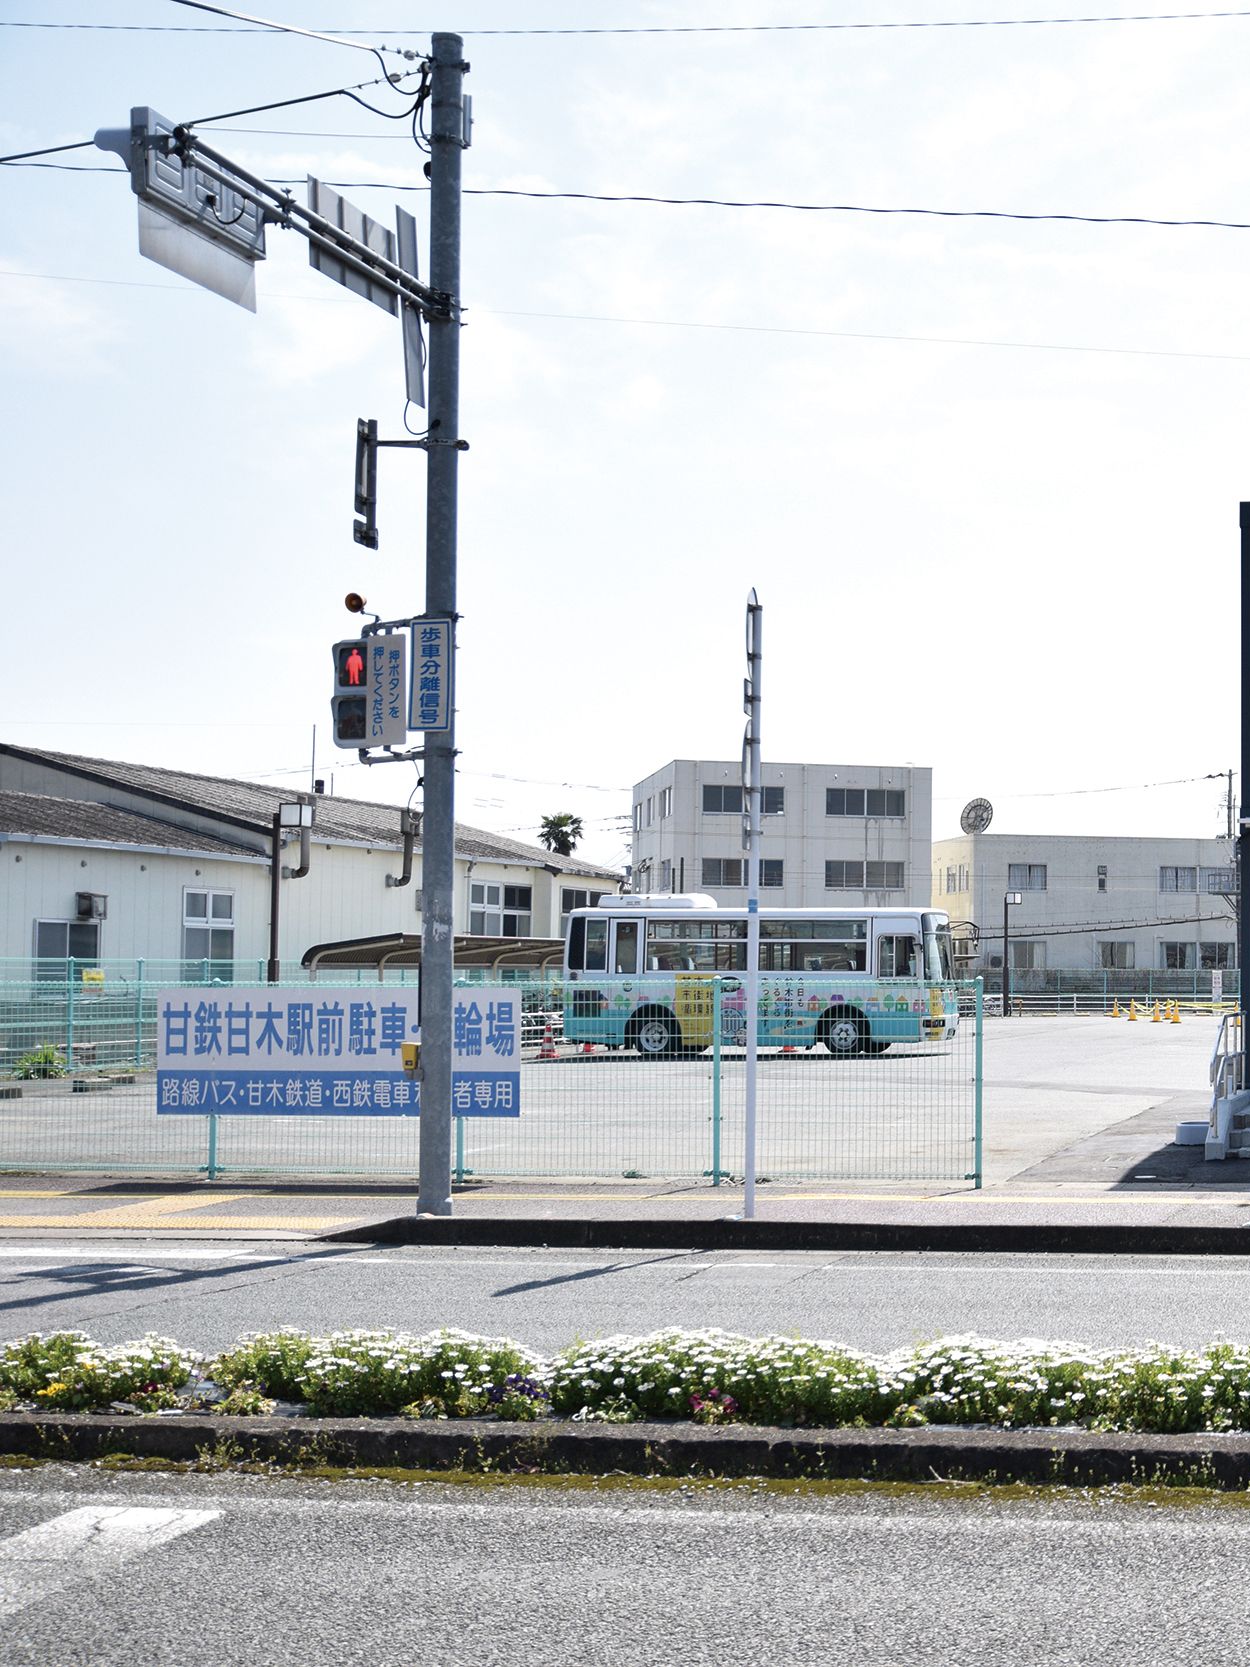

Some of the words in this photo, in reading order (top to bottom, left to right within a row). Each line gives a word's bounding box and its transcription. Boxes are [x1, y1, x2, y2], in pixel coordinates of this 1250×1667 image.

[372, 646, 384, 737] 押してください
[389, 651, 400, 719] 押ボタンを
[419, 627, 441, 724] 歩車分離信号
[163, 1001, 515, 1056] 甘鉄甘木駅前駐車・輪場
[162, 1079, 513, 1109] 路線バス・甘木鉄道・西鉄電車者専用
